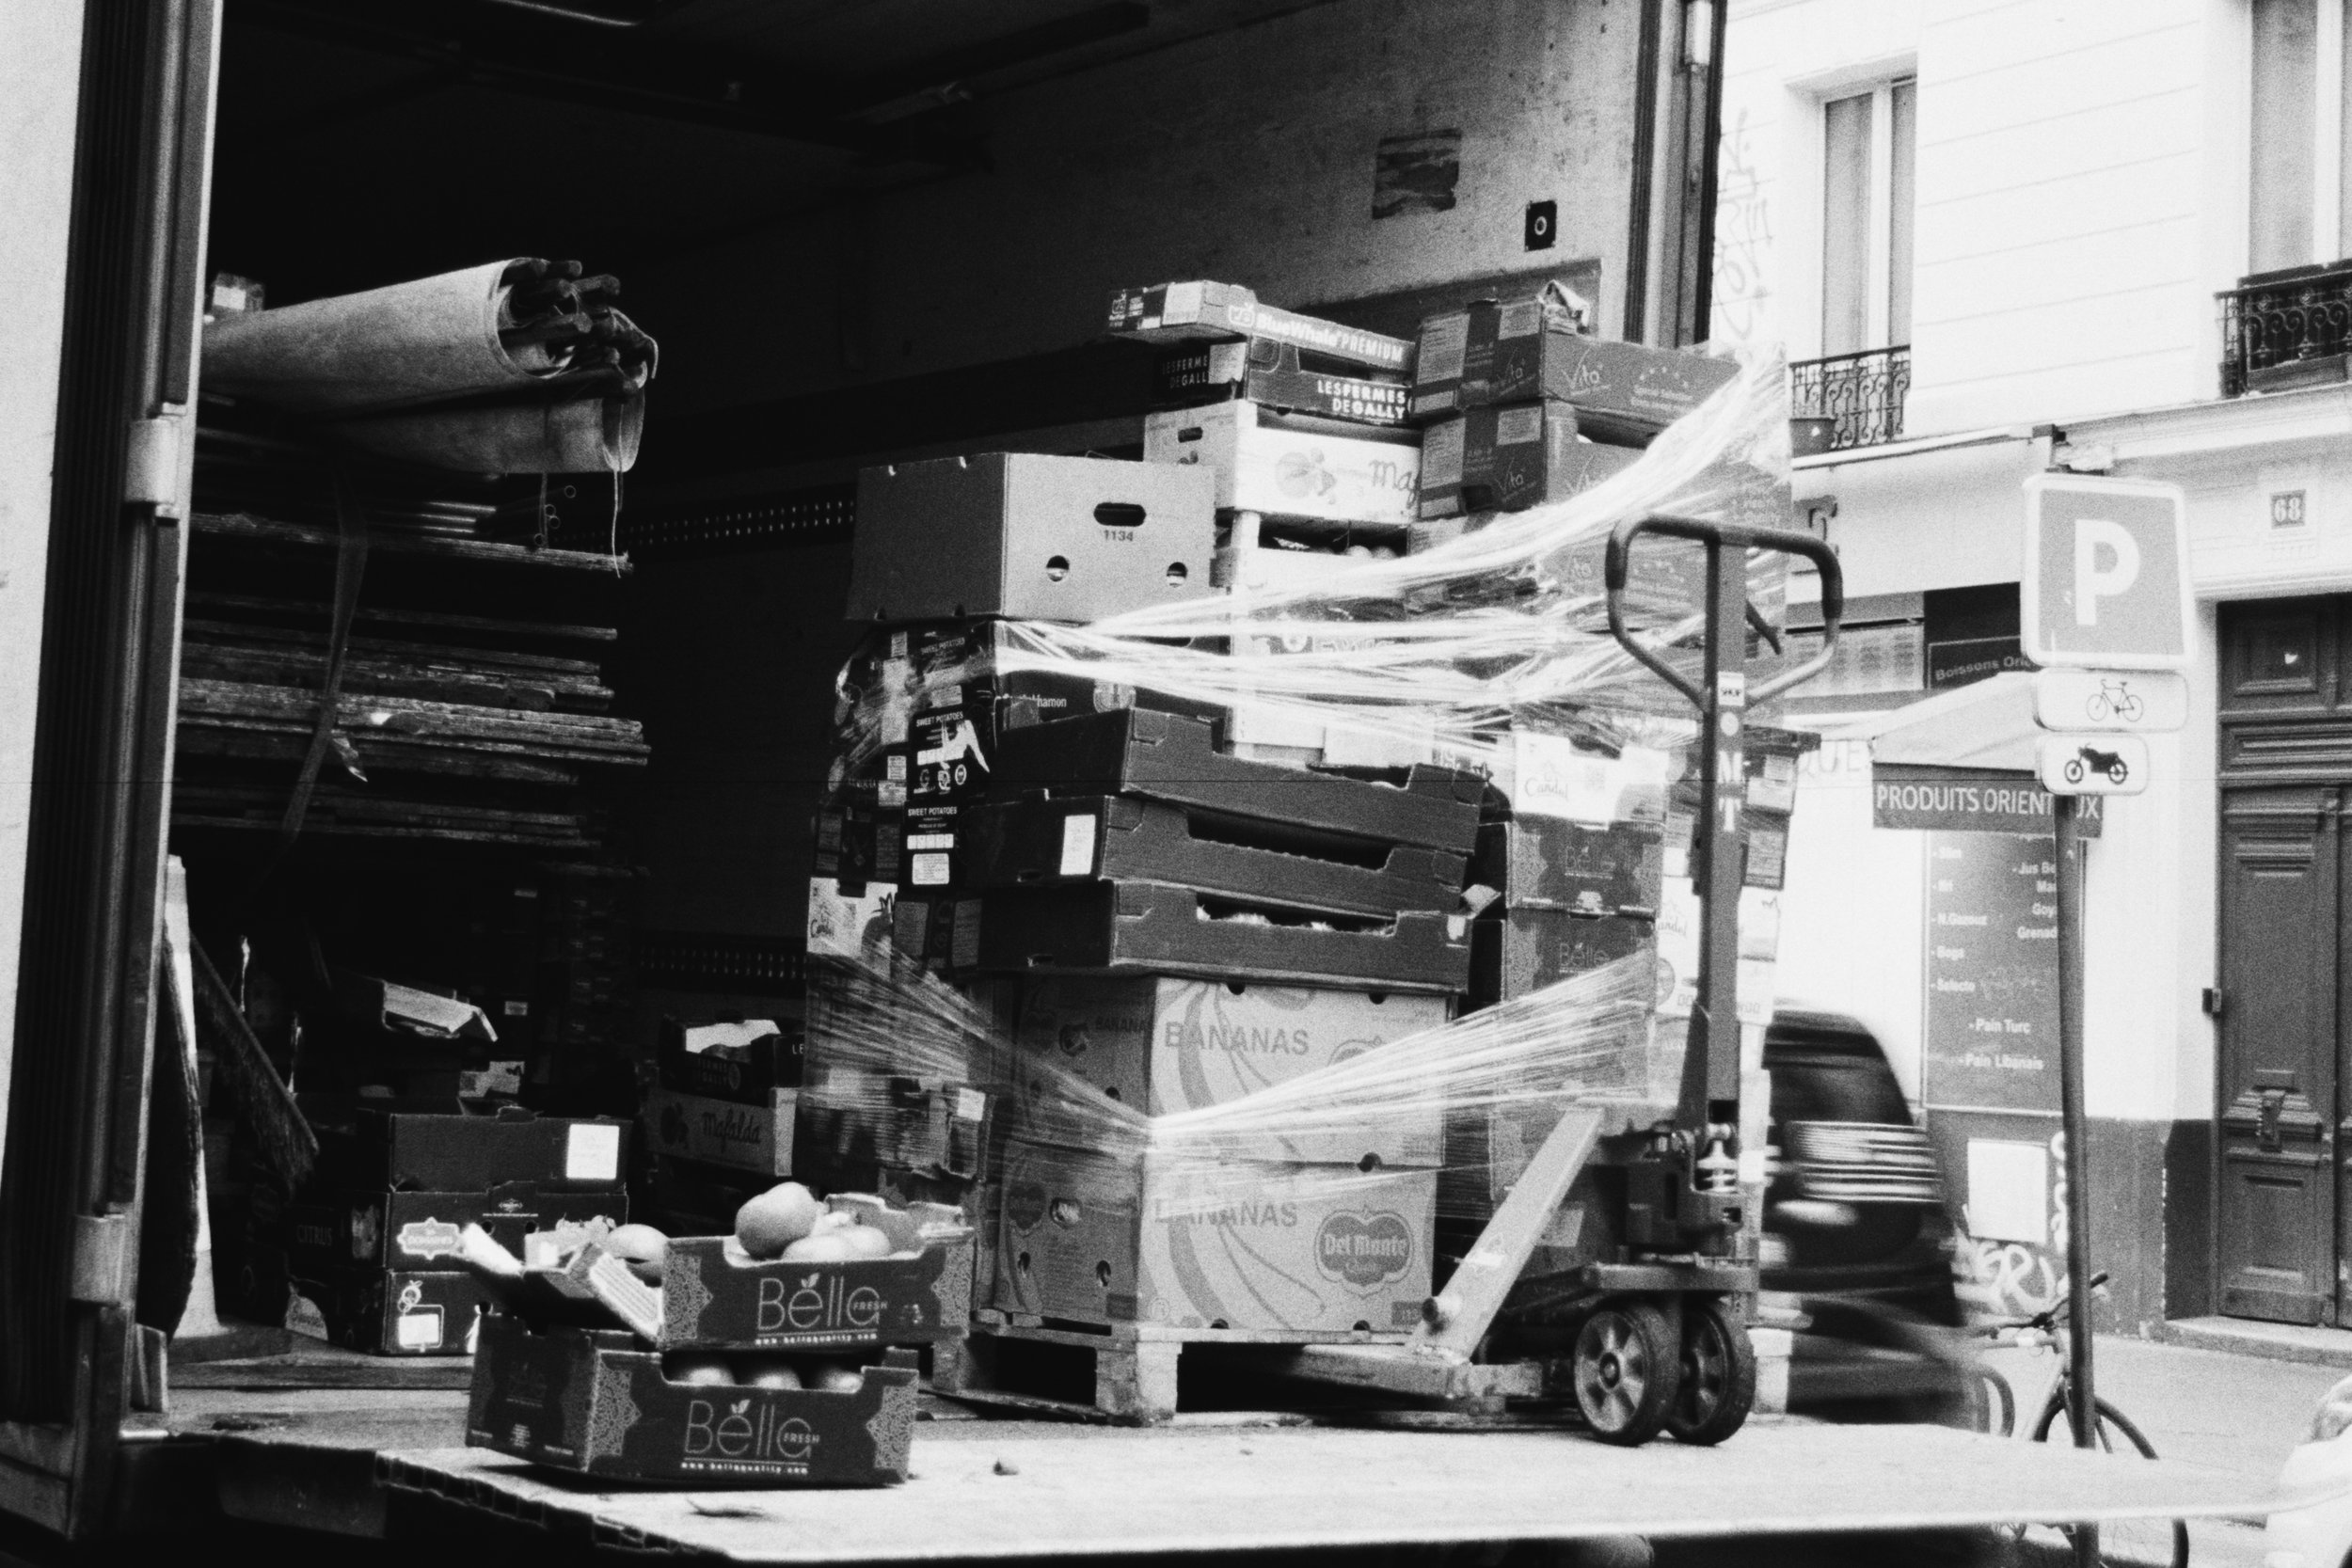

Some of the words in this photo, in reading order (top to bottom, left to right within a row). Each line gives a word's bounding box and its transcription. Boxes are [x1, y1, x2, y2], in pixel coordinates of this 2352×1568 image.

[1341, 335, 1403, 363] PREMIUM
[2274, 497, 2301, 523] 68
[1104, 530, 1135, 543] 1134
[2074, 519, 2139, 626] P
[1876, 784, 1979, 813] PRODUITS
[1983, 788, 2100, 819] ORIENTUX
[2018, 862, 2039, 875] Jus
[1165, 1021, 1311, 1055] BANANAS
[1976, 1018, 2002, 1033] Pain
[2003, 1019, 2032, 1035] Turc
[1965, 1053, 1992, 1068] Pain
[1324, 1233, 1352, 1256] Del
[1354, 1234, 1408, 1257] Monte
